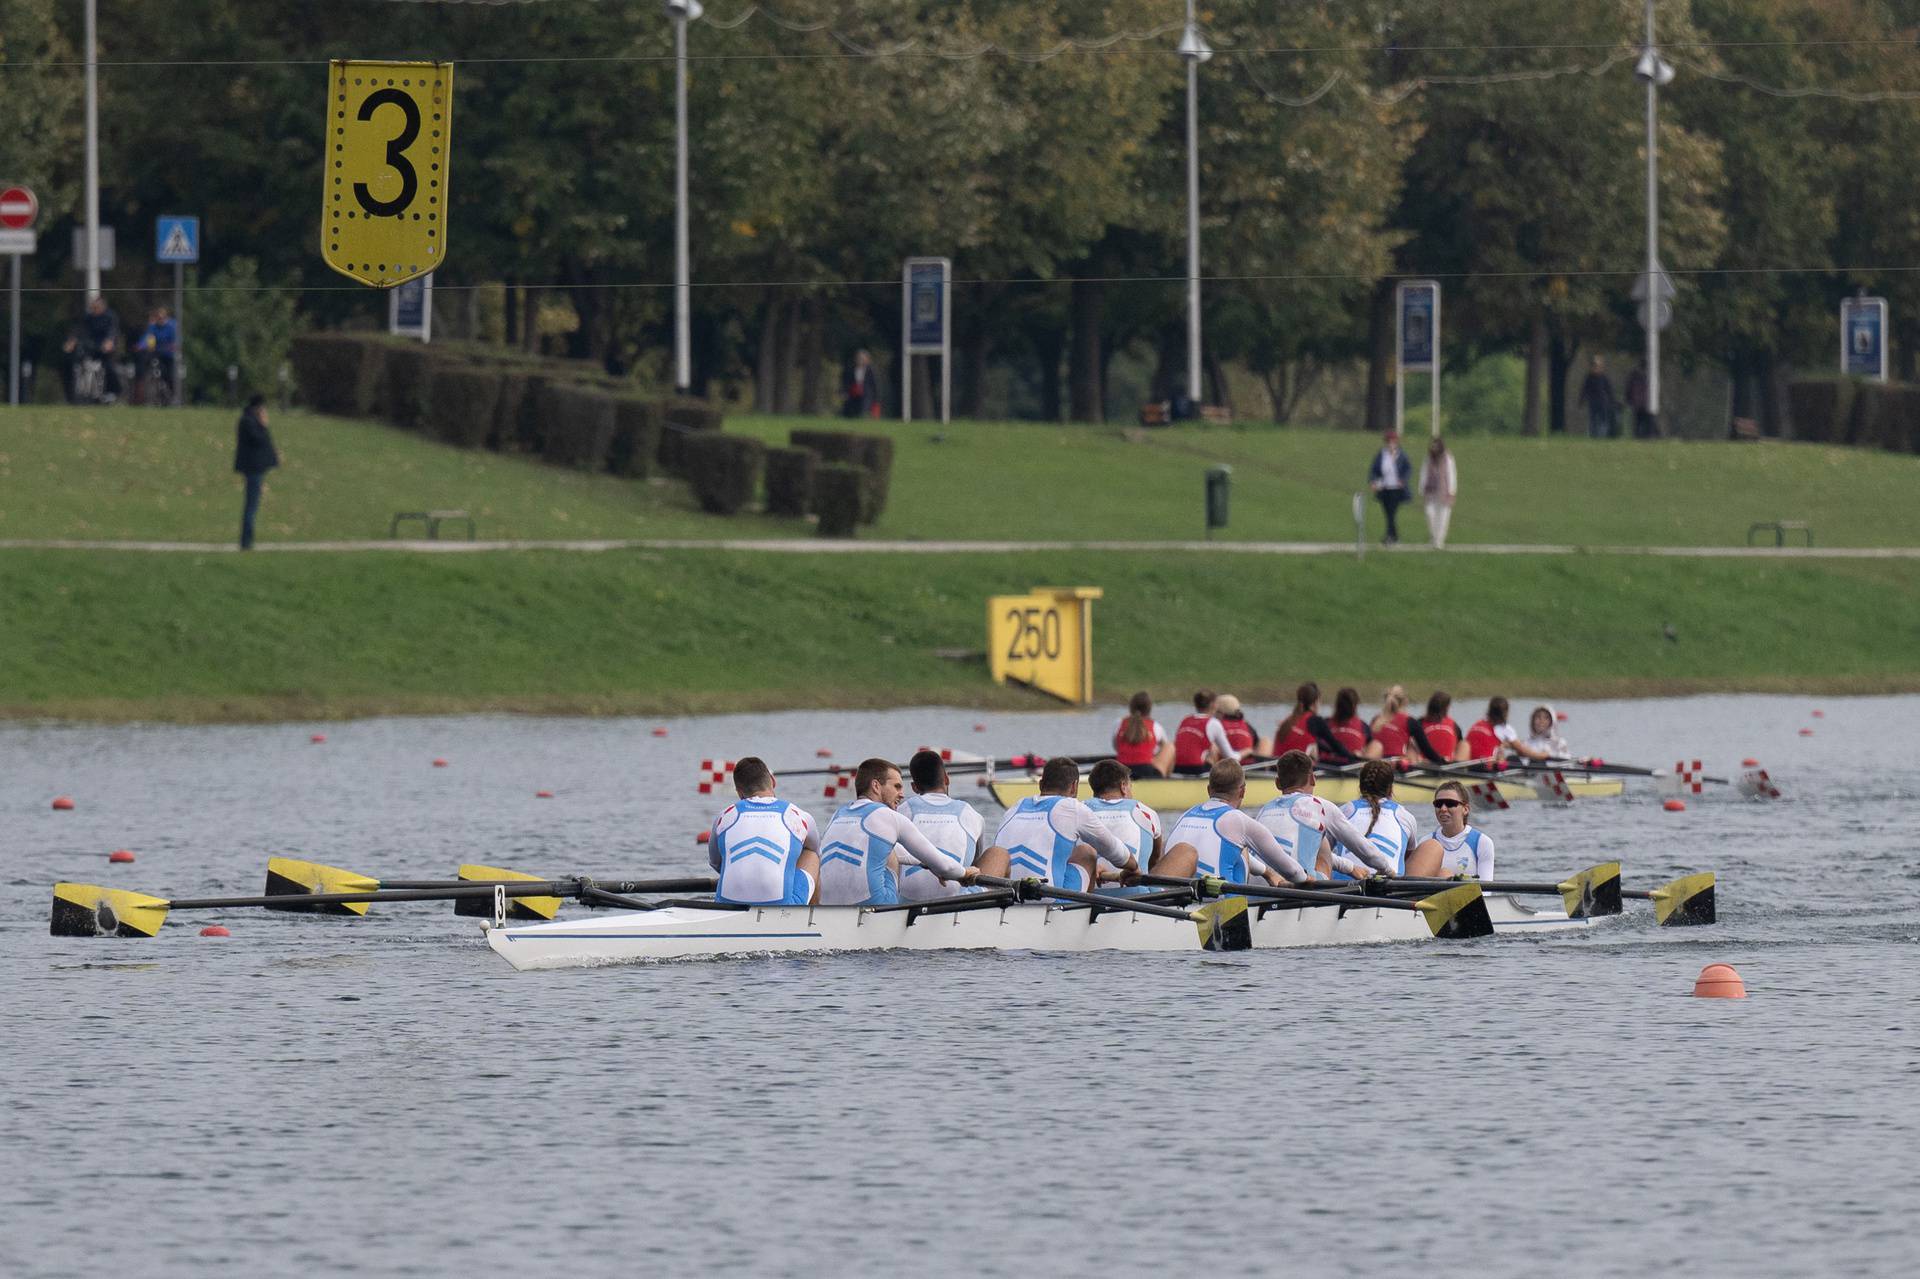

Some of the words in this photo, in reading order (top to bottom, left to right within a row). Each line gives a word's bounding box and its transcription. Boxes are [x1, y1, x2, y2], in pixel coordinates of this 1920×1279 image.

[353, 88, 421, 217] 3
[1007, 608, 1061, 660] 250
[497, 887, 504, 920] 3
